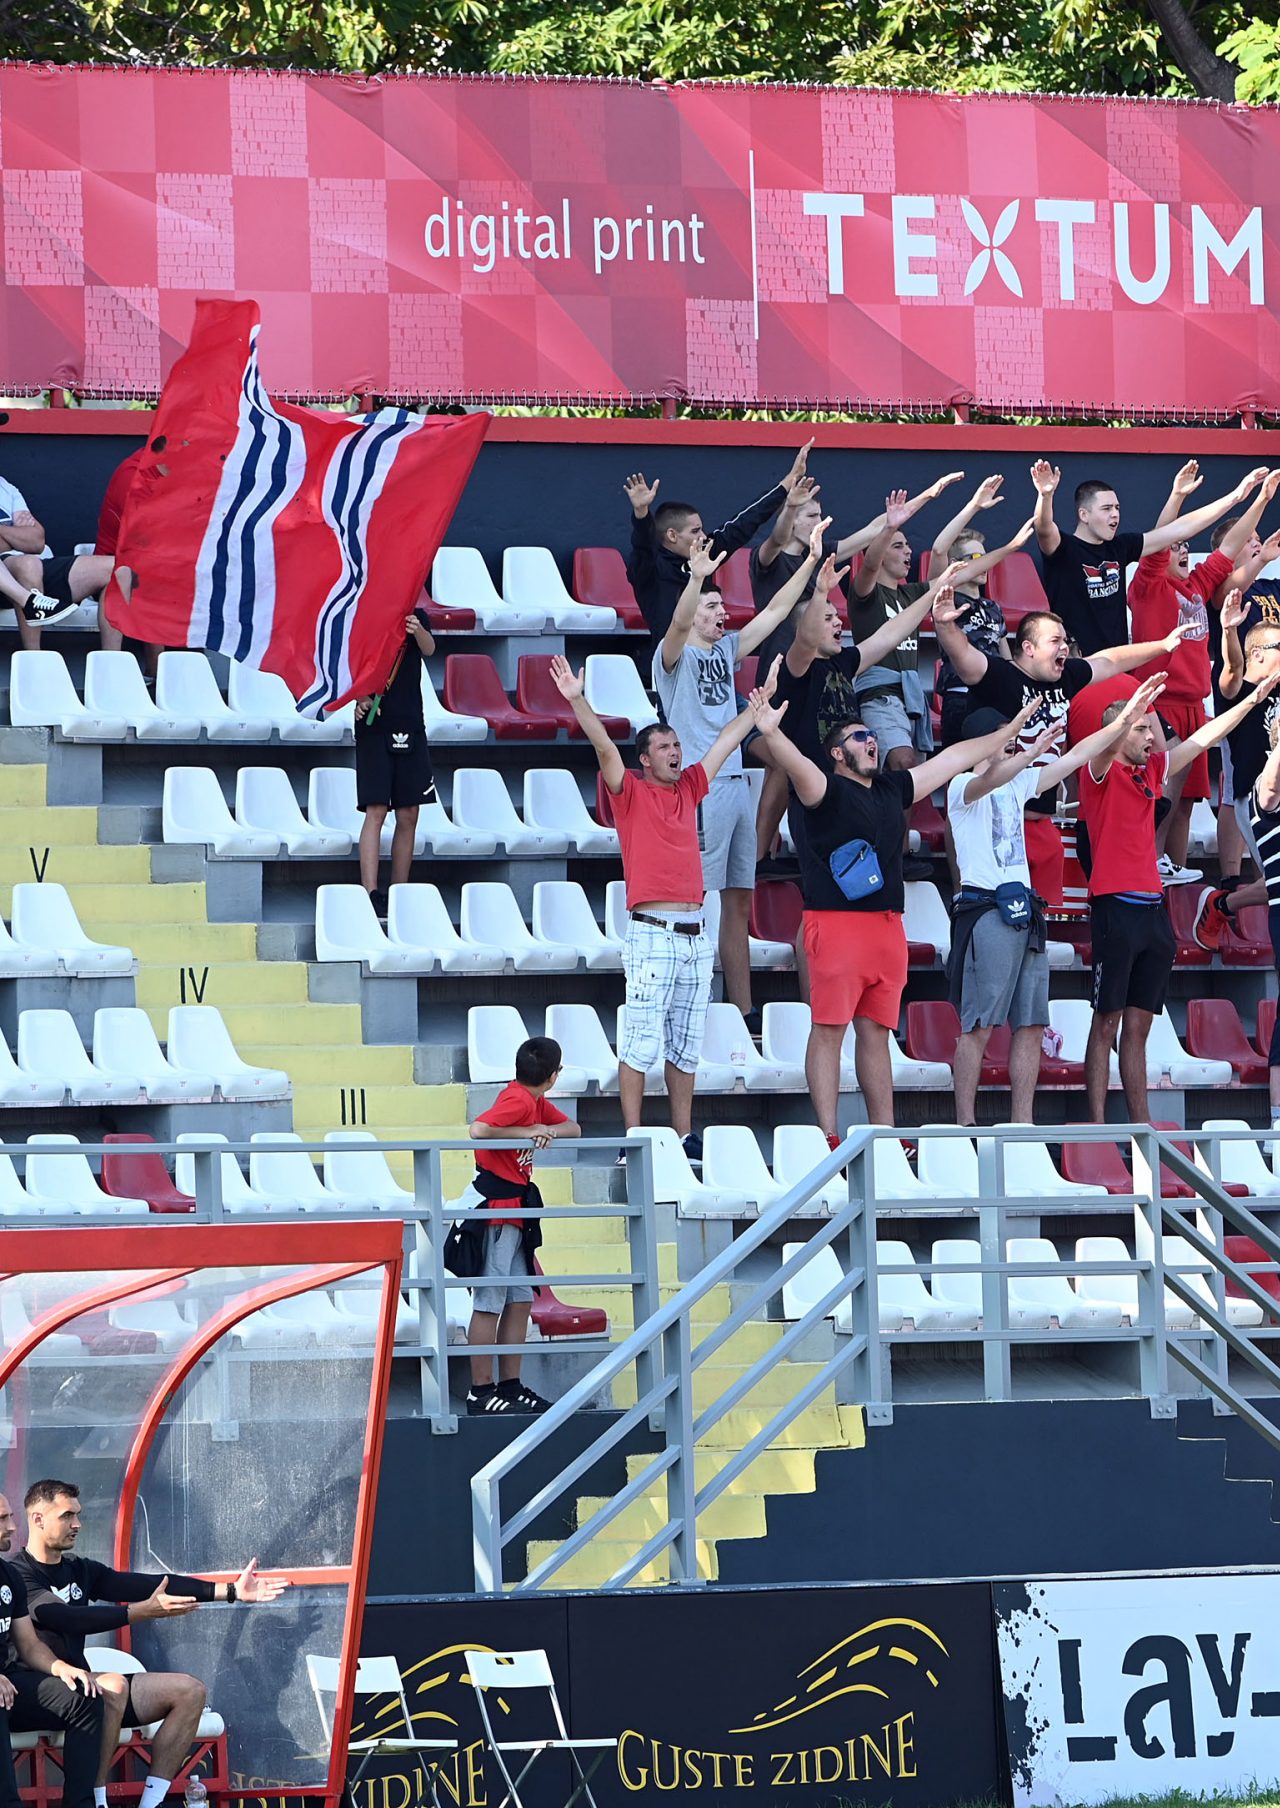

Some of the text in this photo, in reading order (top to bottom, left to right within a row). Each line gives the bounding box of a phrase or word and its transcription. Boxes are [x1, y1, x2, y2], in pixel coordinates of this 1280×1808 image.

[424, 197, 705, 275] digital print
[803, 193, 1265, 306] TEXTUM
[30, 848, 50, 883] V
[180, 966, 209, 1004] IV
[340, 1088, 366, 1126] III
[616, 1710, 918, 1791] GUSTE ZIDINE
